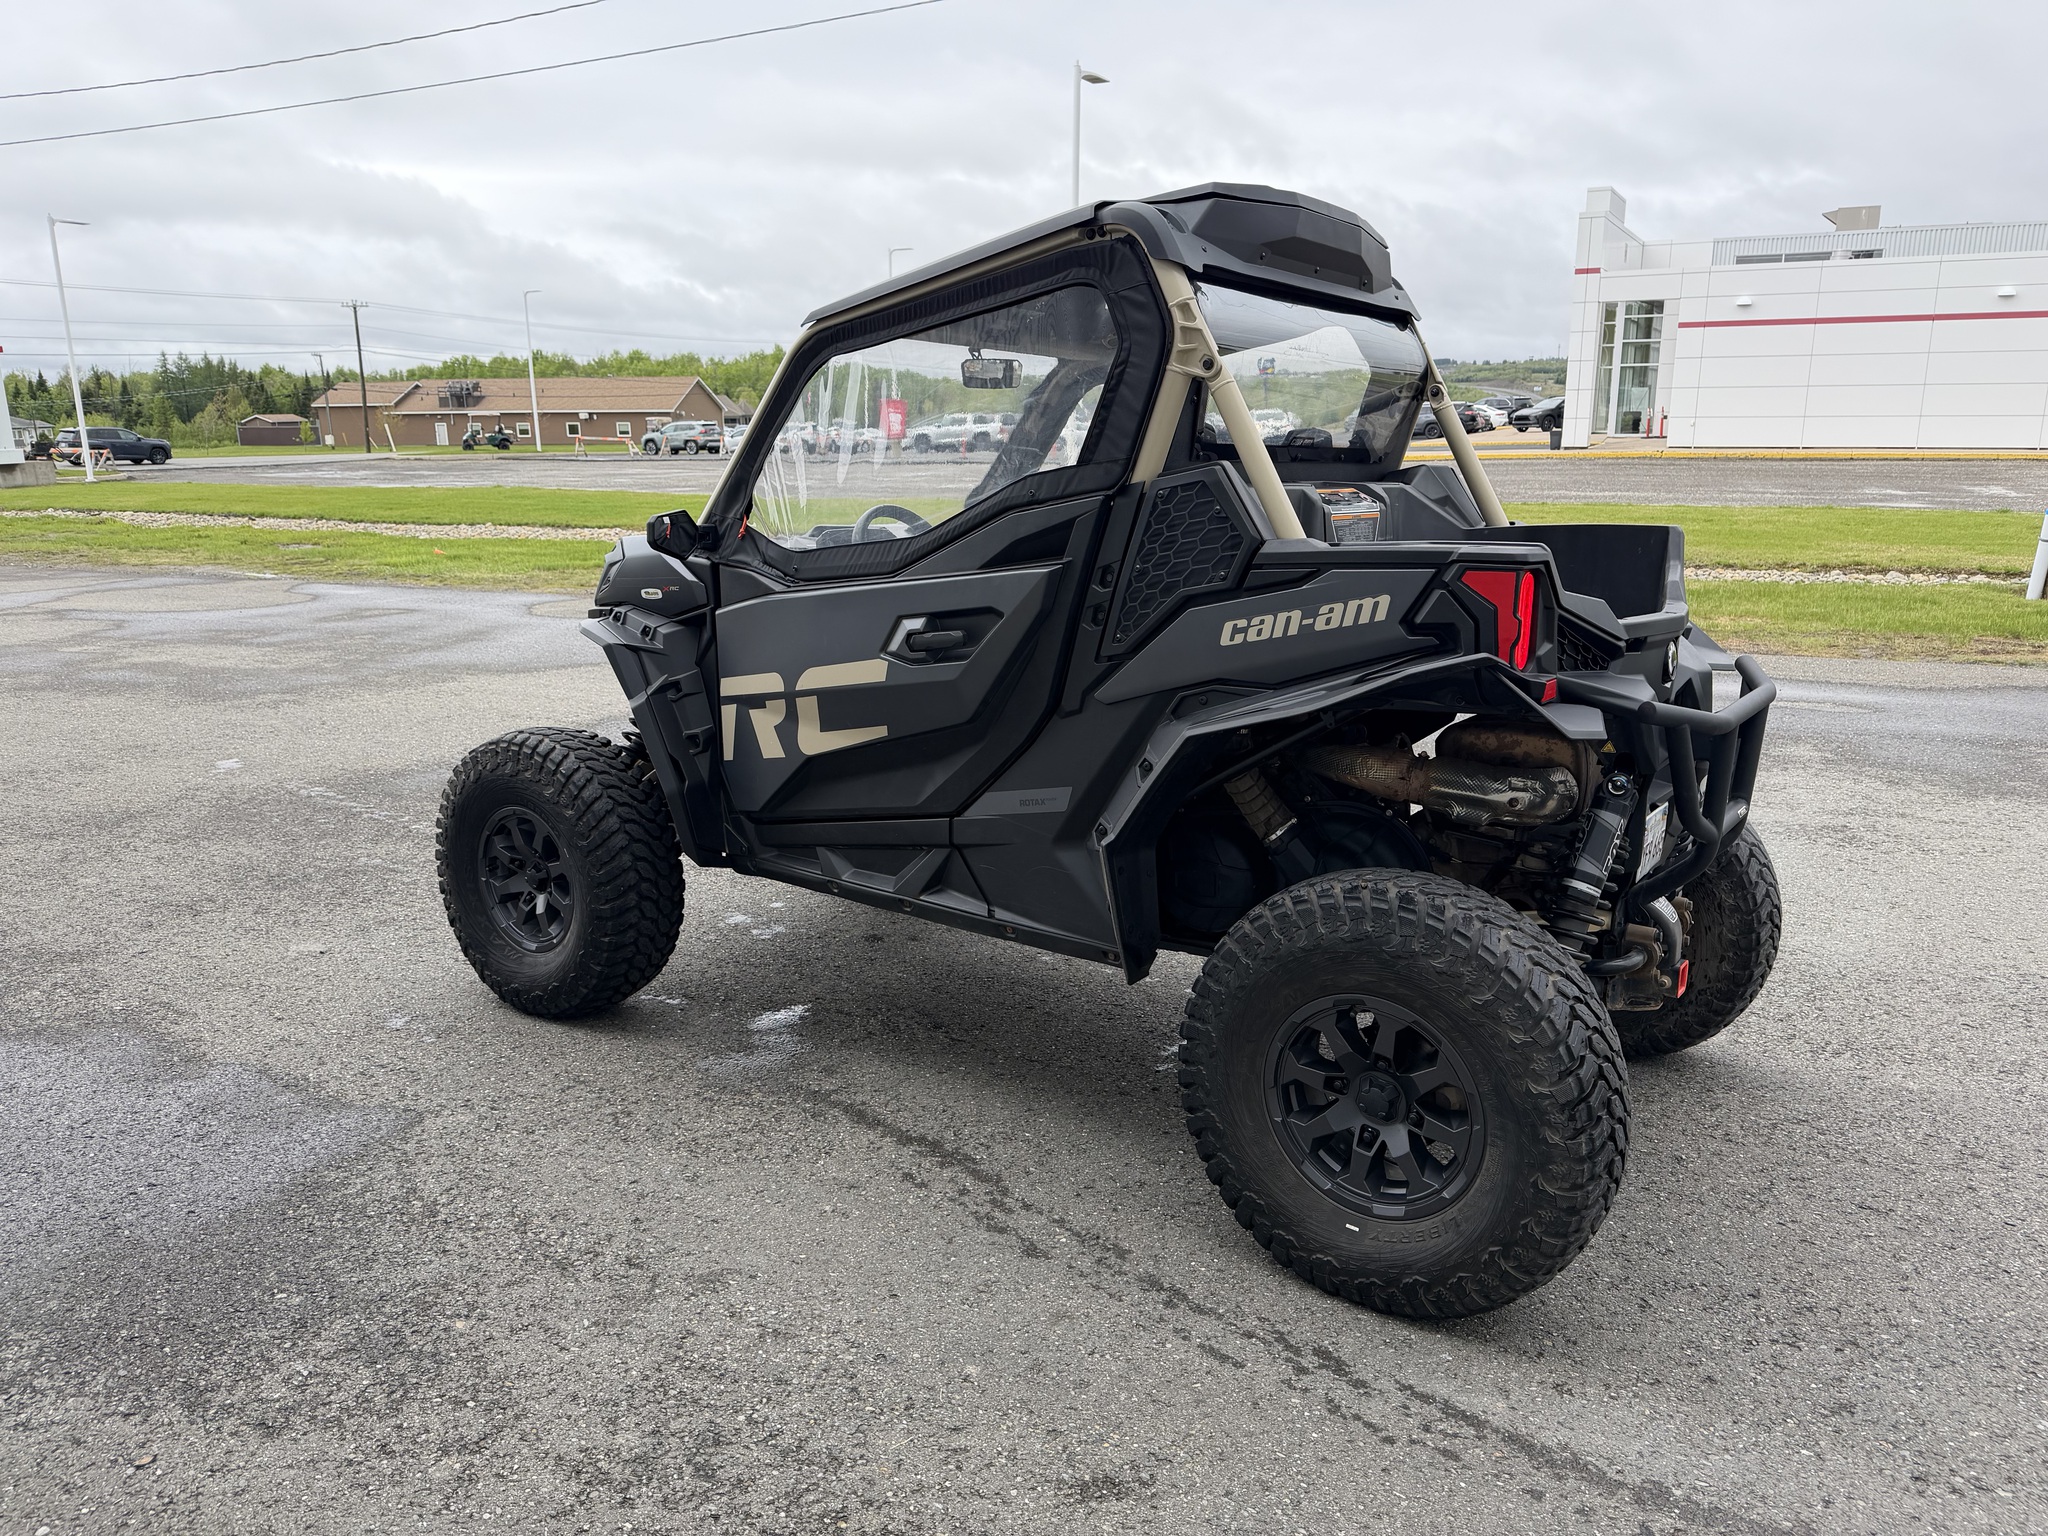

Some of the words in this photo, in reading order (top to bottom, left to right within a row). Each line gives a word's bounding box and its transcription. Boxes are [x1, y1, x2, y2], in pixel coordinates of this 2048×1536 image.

[1219, 594, 1392, 647] can-am
[720, 659, 889, 761] RC
[1019, 798, 1046, 807] ROTAX
[1368, 1215, 1461, 1244] LIBERTY
